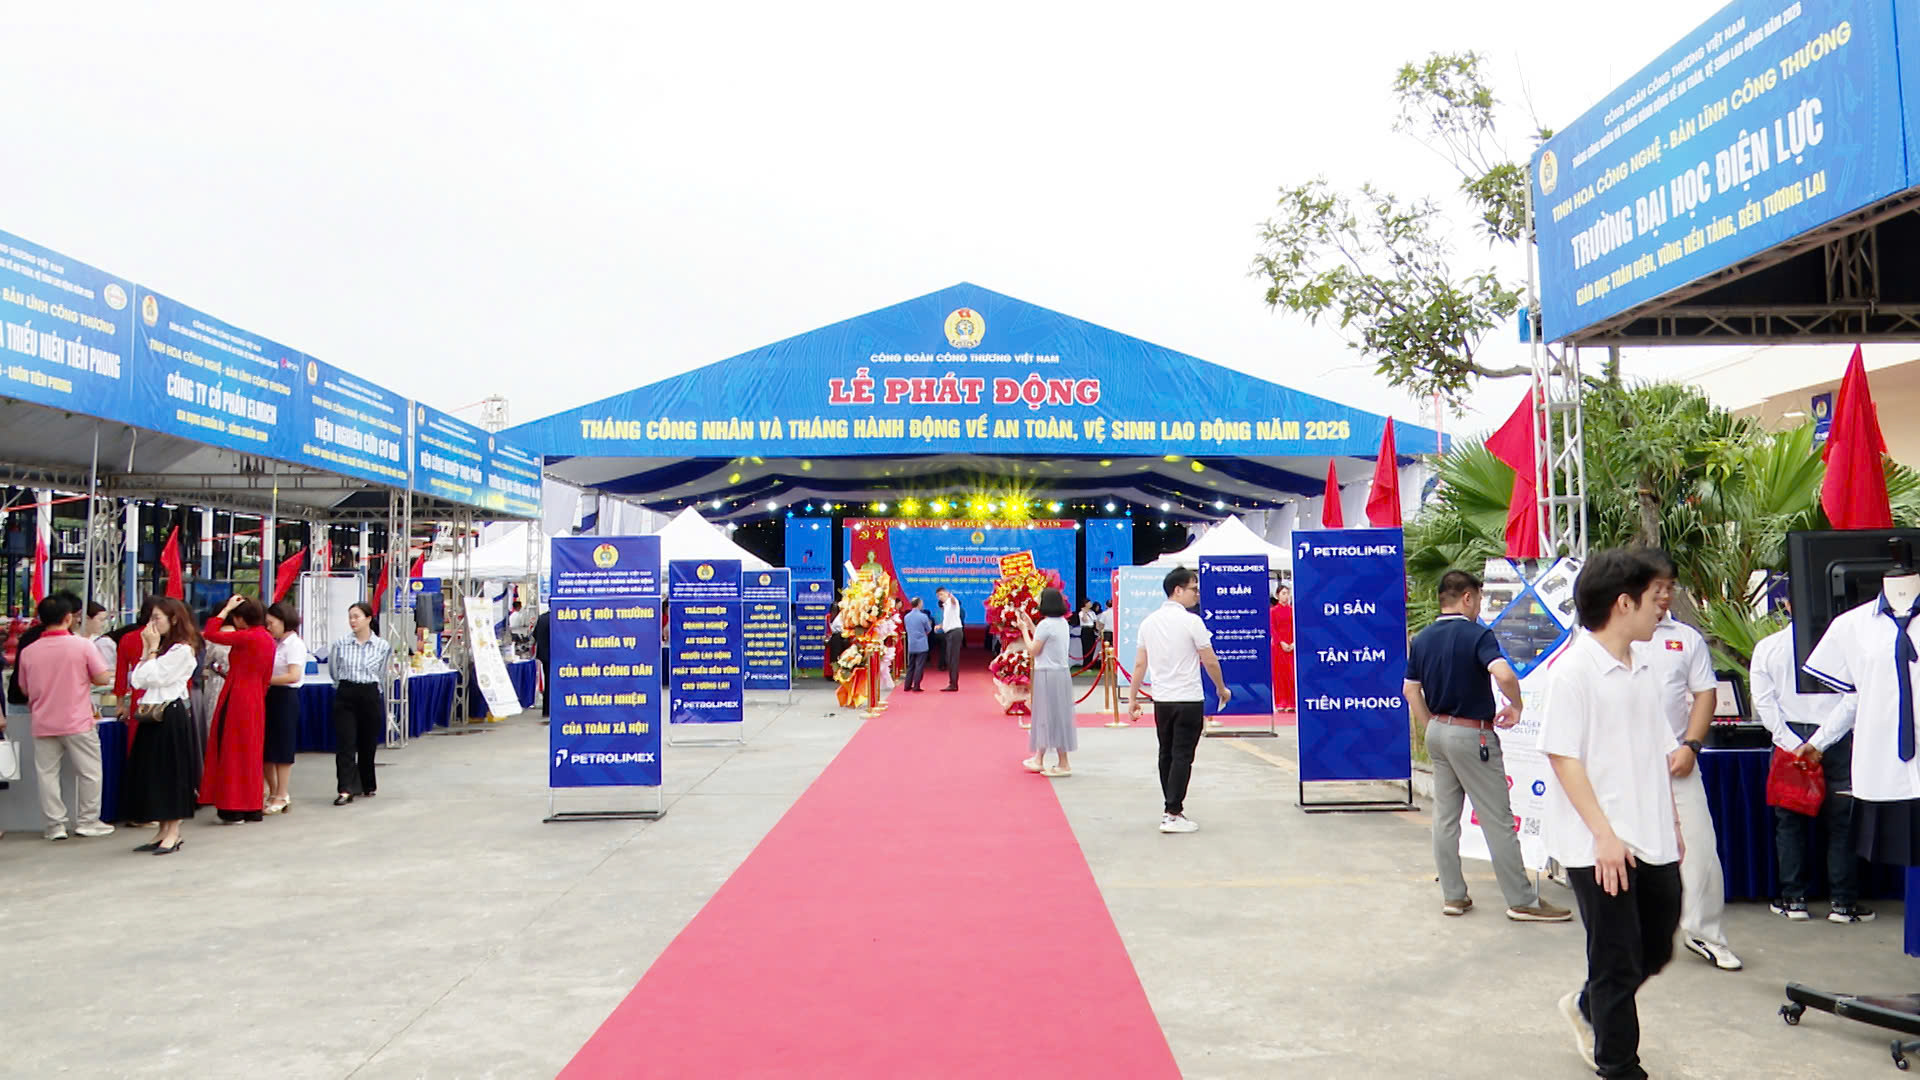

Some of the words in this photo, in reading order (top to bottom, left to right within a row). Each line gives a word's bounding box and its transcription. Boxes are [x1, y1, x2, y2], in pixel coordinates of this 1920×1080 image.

[1724, 16, 1746, 41] NAM
[1552, 198, 1573, 223] TINH
[1573, 184, 1595, 210] HOA
[1596, 162, 1629, 194] CÔNG
[1630, 135, 1662, 174] NGHỆ
[1670, 118, 1696, 150] BẢN
[1698, 97, 1728, 132] LĨNH
[1731, 68, 1778, 110] CÔNG
[1780, 20, 1852, 80] THƯƠNG
[1571, 205, 1634, 270] TRƯỜNG
[1636, 185, 1668, 238] ĐẠI
[1670, 161, 1712, 219] HỌC
[1716, 128, 1770, 194] ĐIỆN
[1774, 98, 1824, 165] LỰC
[1611, 264, 1632, 290] TOÀN
[1762, 180, 1804, 218] TƯƠNG
[1804, 170, 1826, 200] LAI
[2, 285, 24, 306] BẢN
[50, 303, 79, 324] CÔNG
[6, 320, 38, 358] THIẾU
[40, 330, 65, 364] NIÊN
[90, 346, 120, 380] PHONG
[870, 352, 901, 363] CÔNG
[904, 352, 934, 363] ĐOÀN
[936, 352, 968, 363] CÔNG
[970, 353, 1012, 364] THƯƠNG
[1014, 352, 1034, 366] VIỆT
[1036, 354, 1060, 364] NAM
[167, 370, 194, 402] CÔNG
[196, 382, 208, 406] TY
[208, 381, 223, 410] CỔ
[222, 388, 248, 418] PHẦN
[829, 367, 875, 405] LỄ
[884, 372, 984, 405] PHÁT
[992, 372, 1100, 410] ĐỘNG
[580, 416, 642, 440] THÁNG
[646, 416, 697, 440] CÔNG
[702, 416, 754, 440] NHÂN
[759, 416, 784, 440] VÀ
[788, 416, 849, 439] THÁNG
[854, 416, 904, 439] HÀNH
[909, 416, 960, 442] ĐỘNG
[966, 413, 988, 438] VỀ
[993, 419, 1020, 438] AN
[1024, 416, 1078, 441] TOÀN,
[1084, 416, 1106, 444] VỆ
[1111, 421, 1156, 440] SINH
[1160, 421, 1196, 440] LAO
[1200, 417, 1252, 445] ĐỘNG
[1256, 417, 1300, 440] NĂM
[1304, 420, 1350, 440] 2026
[1313, 545, 1397, 558] PETROLIMEX
[1216, 586, 1228, 596] DI
[1230, 584, 1252, 594] SẢN
[558, 606, 578, 620] BẢO
[580, 608, 592, 622] VỆ
[594, 606, 614, 620] MÔI
[616, 605, 654, 618] TRƯỜNG
[1324, 603, 1340, 616] DI
[1343, 599, 1376, 616] SẢN
[576, 635, 588, 648] LÀ
[590, 635, 620, 648] NGHĨA
[622, 636, 636, 650] VỤ
[1316, 647, 1349, 666] TẬN
[1352, 646, 1386, 662] TÂM
[559, 664, 579, 678] CỦA
[602, 664, 630, 676] CÔNG
[632, 663, 653, 676] DÂN
[564, 693, 578, 706] VÀ
[580, 693, 612, 706] TRÁCH
[614, 692, 646, 707] NHIỆM
[683, 700, 739, 710] PETROLIMEX
[1304, 694, 1341, 710] TIÊN
[1344, 697, 1402, 710] PHONG
[562, 721, 582, 735] CỦA
[584, 721, 610, 734] TOÀN
[612, 721, 626, 734] XÃ
[628, 720, 649, 736] HỘI!
[571, 752, 656, 764] PETROLIMEX
